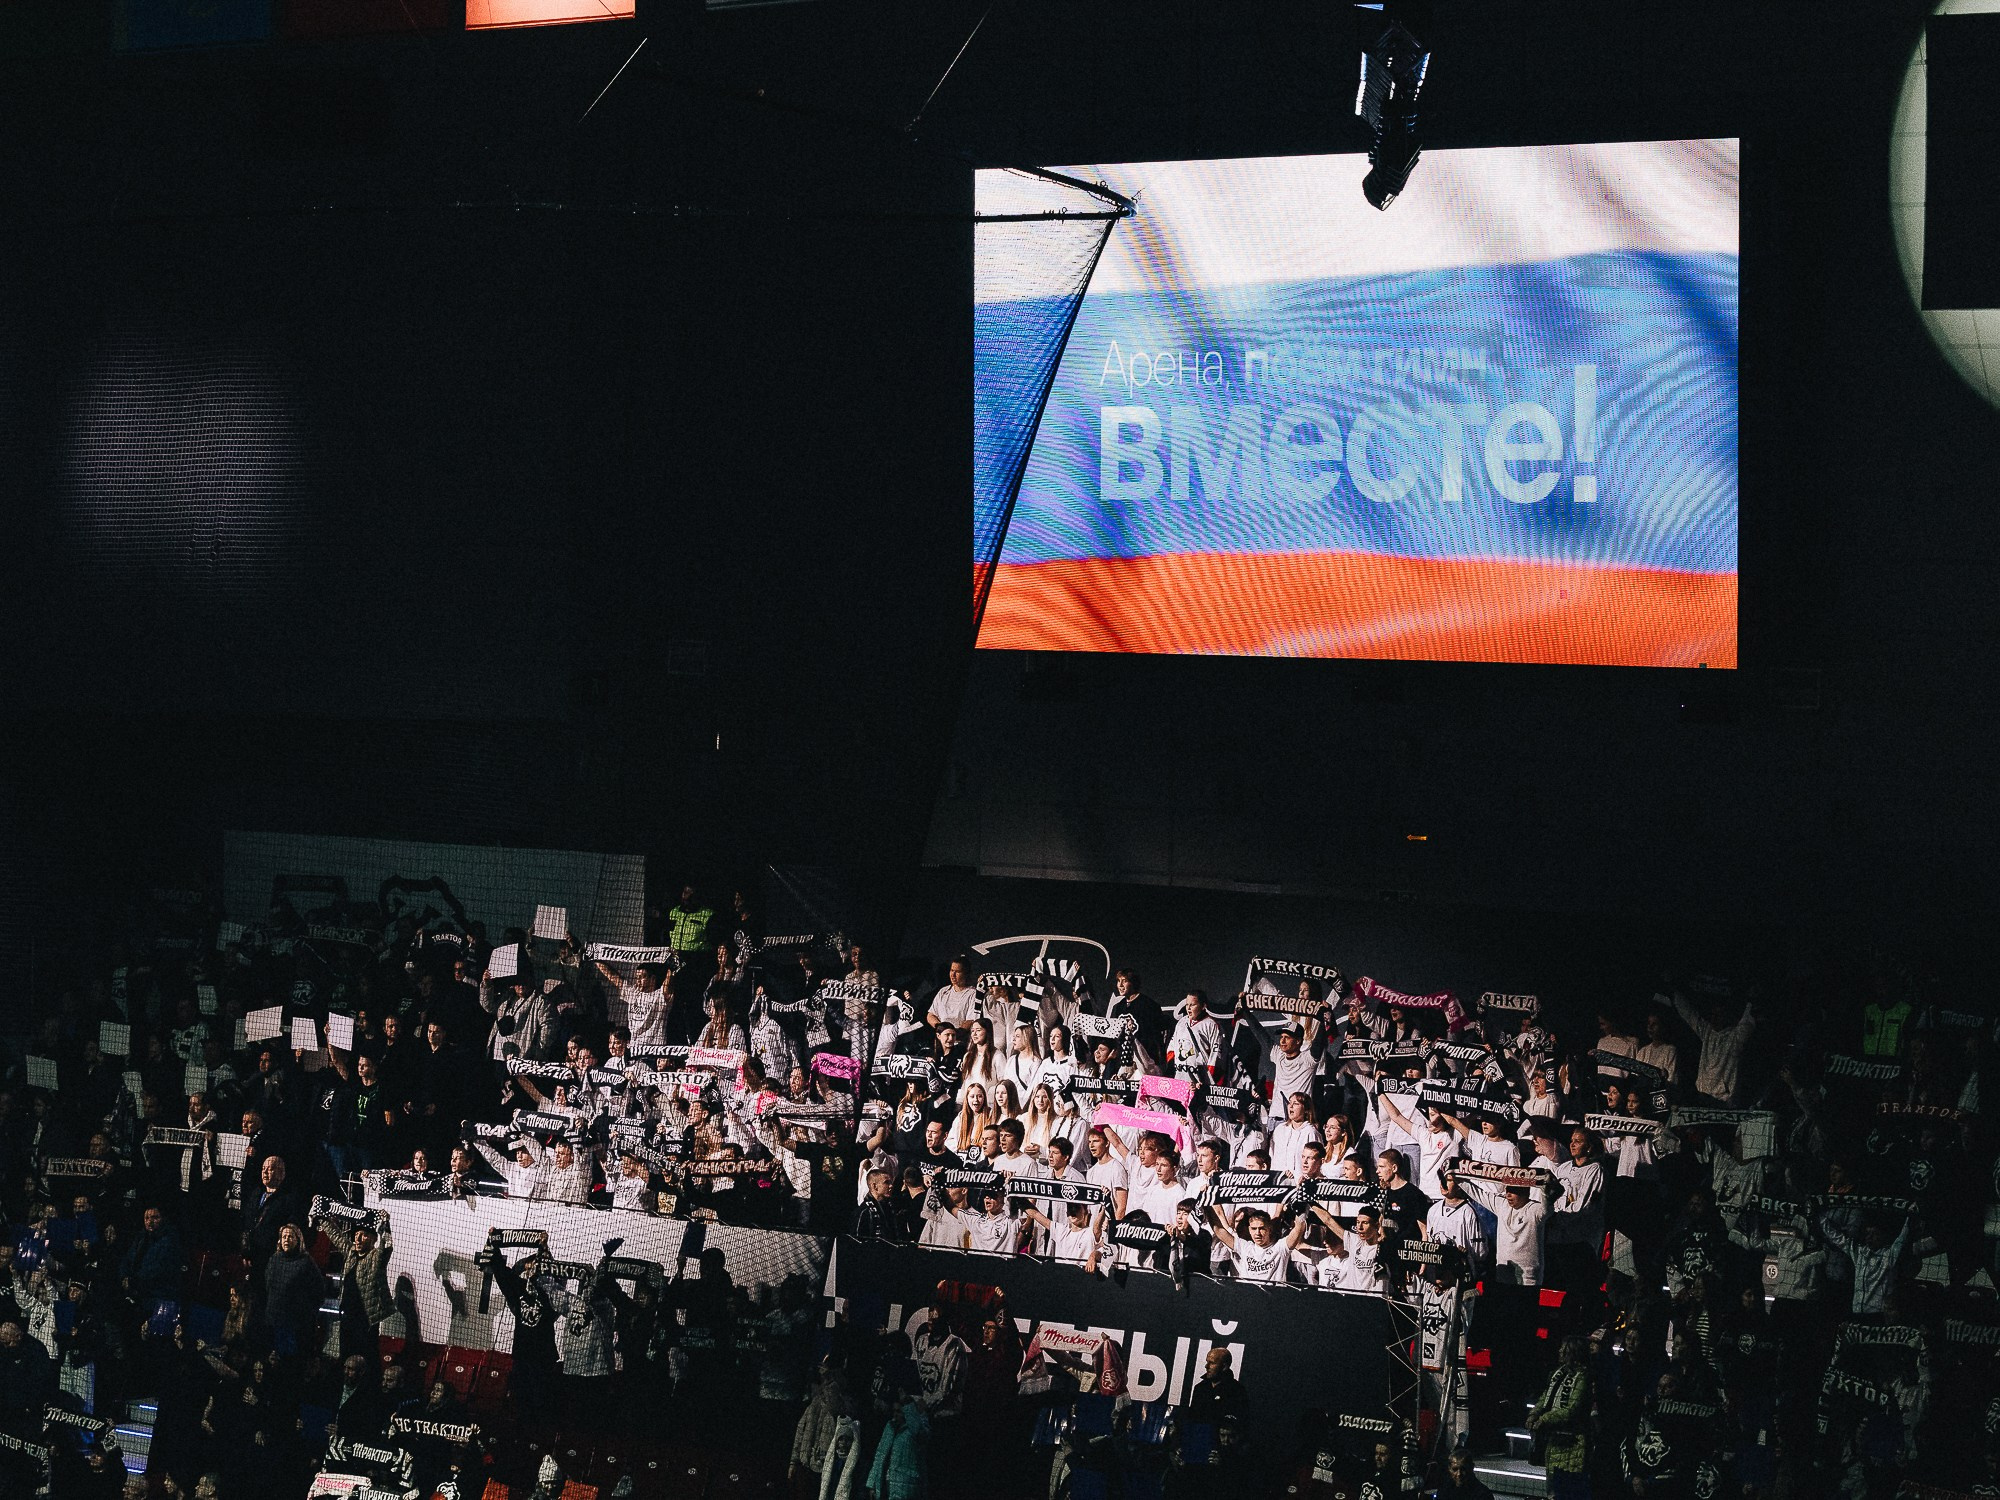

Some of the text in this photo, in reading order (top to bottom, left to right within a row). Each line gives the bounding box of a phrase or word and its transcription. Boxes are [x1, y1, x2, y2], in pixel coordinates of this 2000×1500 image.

[1100, 340, 1229, 398] Арена,
[431, 933, 463, 946] TRAKTOR
[1253, 958, 1338, 980] ТРАКТОР
[1074, 1077, 1101, 1089] ТОЛЬКО
[1382, 1079, 1397, 1092] 19
[1209, 1084, 1238, 1098] ТРАКТОР
[1423, 1089, 1451, 1104] ТОЛЬКО
[1205, 1095, 1240, 1110] ЧЕЛЯБИНСК
[526, 1113, 565, 1131] ТРАКТОР
[1458, 1160, 1479, 1175] HC
[944, 1169, 998, 1184] ТРАКТОР
[1219, 1171, 1269, 1187] ТРАКТОР
[393, 1178, 434, 1192] ТРАКТОР
[1219, 1185, 1288, 1199] ТРАКТОР
[1316, 1181, 1369, 1197] ТРАКТОР
[329, 1201, 367, 1220] ТРАКТОР
[501, 1229, 543, 1244] ТРАКТОР
[1115, 1222, 1167, 1242] ТРАКТОР
[1403, 1239, 1439, 1253] ТРАКТОР
[1397, 1250, 1443, 1265] ЧЕЛЯБИНСК
[1042, 1327, 1101, 1351] Трактор
[46, 1406, 104, 1431] ТРАКТОР
[352, 1442, 393, 1464] ТРАКТОР
